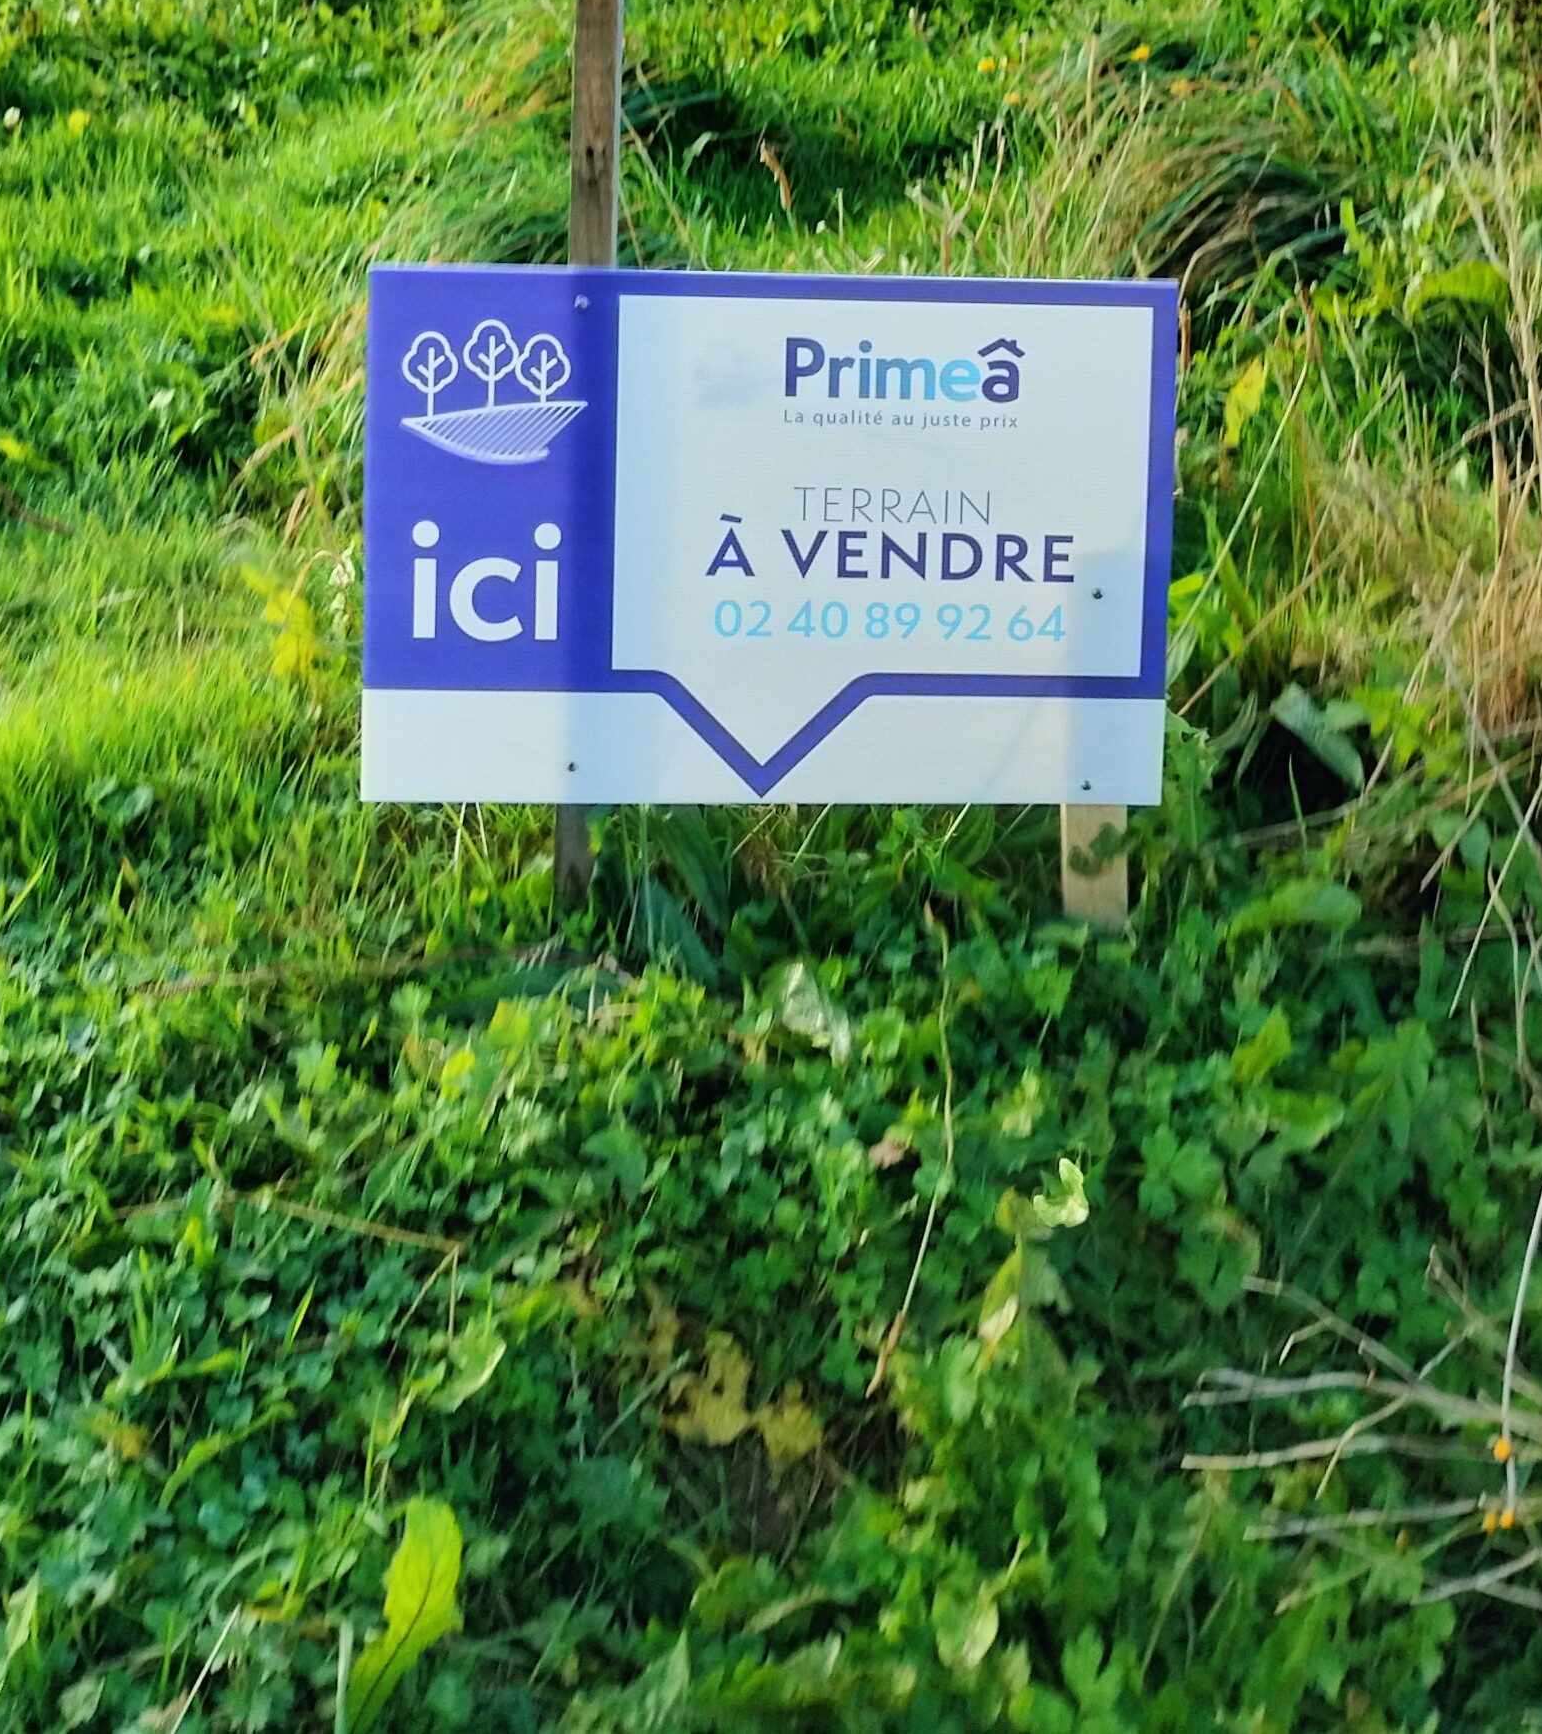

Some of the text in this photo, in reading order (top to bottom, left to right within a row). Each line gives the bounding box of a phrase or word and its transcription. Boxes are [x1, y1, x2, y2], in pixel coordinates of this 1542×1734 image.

[784, 336, 1026, 403] Primeâ
[783, 409, 1019, 430] La qualité au juste prix
[794, 487, 991, 525] TERRAIN
[705, 513, 1076, 583] À VENDRE
[411, 519, 563, 642] ici
[713, 599, 1066, 642] 02 40 89 92 64
